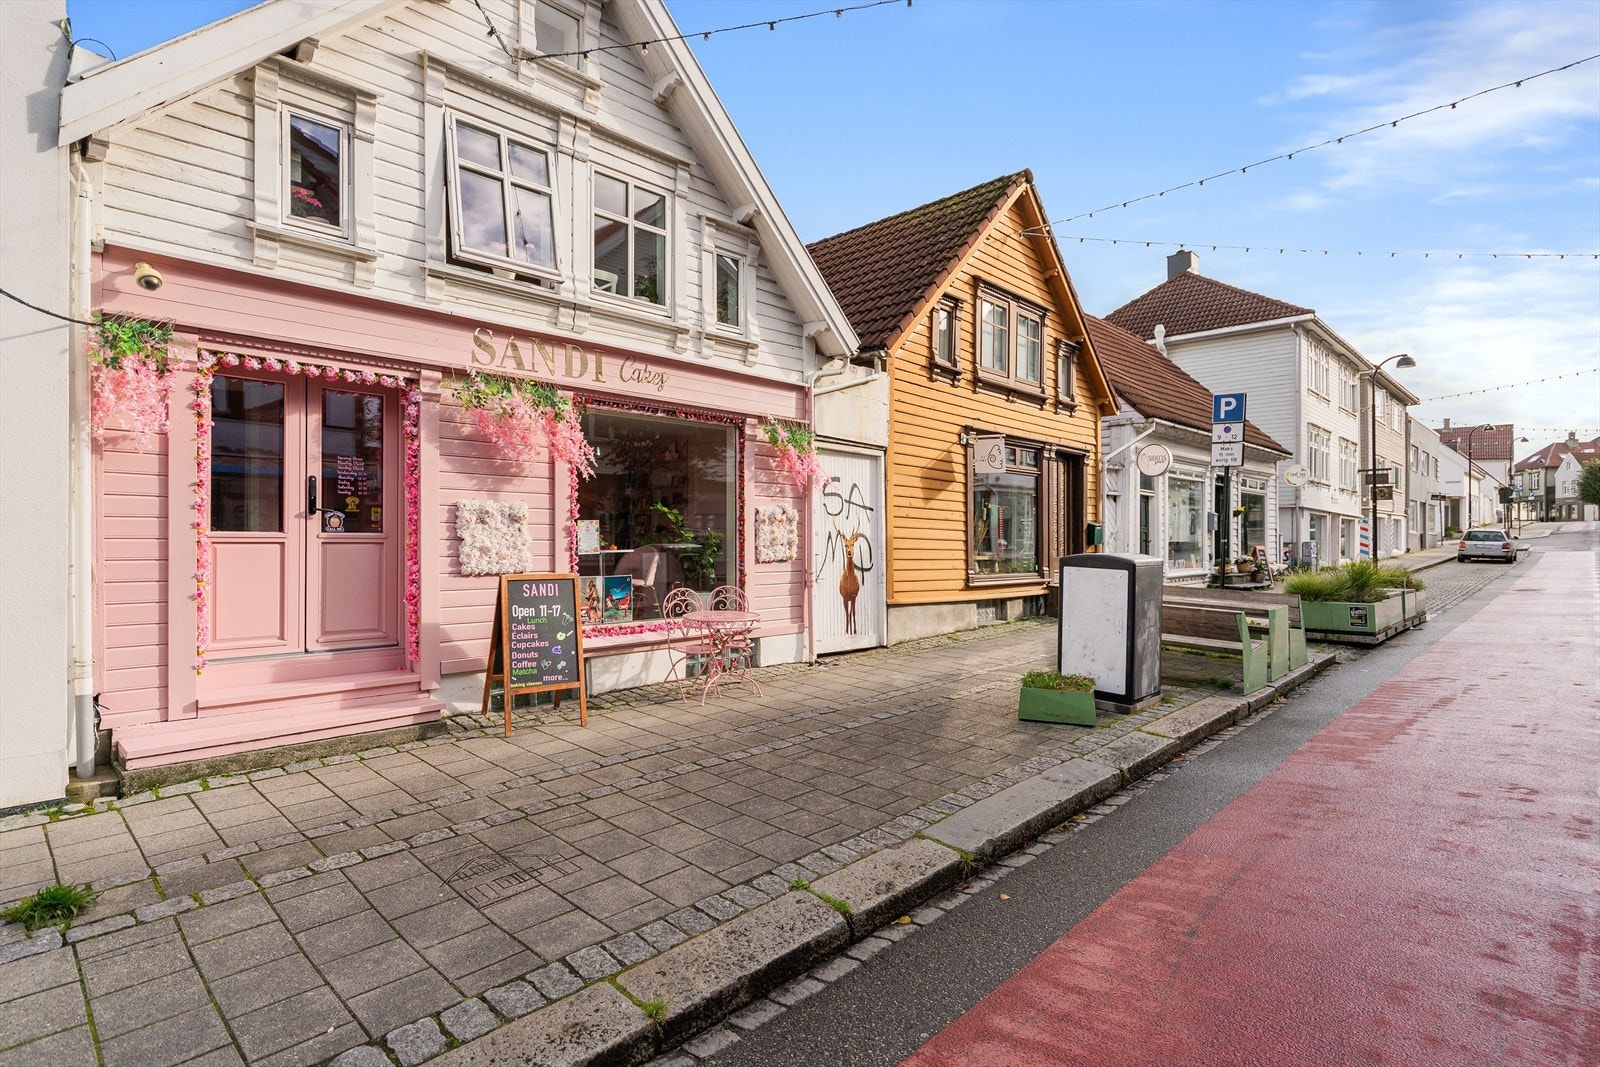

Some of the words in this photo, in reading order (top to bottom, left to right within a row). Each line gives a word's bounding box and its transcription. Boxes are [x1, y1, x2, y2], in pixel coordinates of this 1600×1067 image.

[471, 327, 606, 384] SANDI
[619, 355, 670, 392] Cakes
[1220, 398, 1237, 419] P
[523, 583, 559, 597] SANDI
[512, 605, 535, 620] Open
[540, 604, 561, 617] 11-17
[512, 640, 549, 650] Cupcakes
